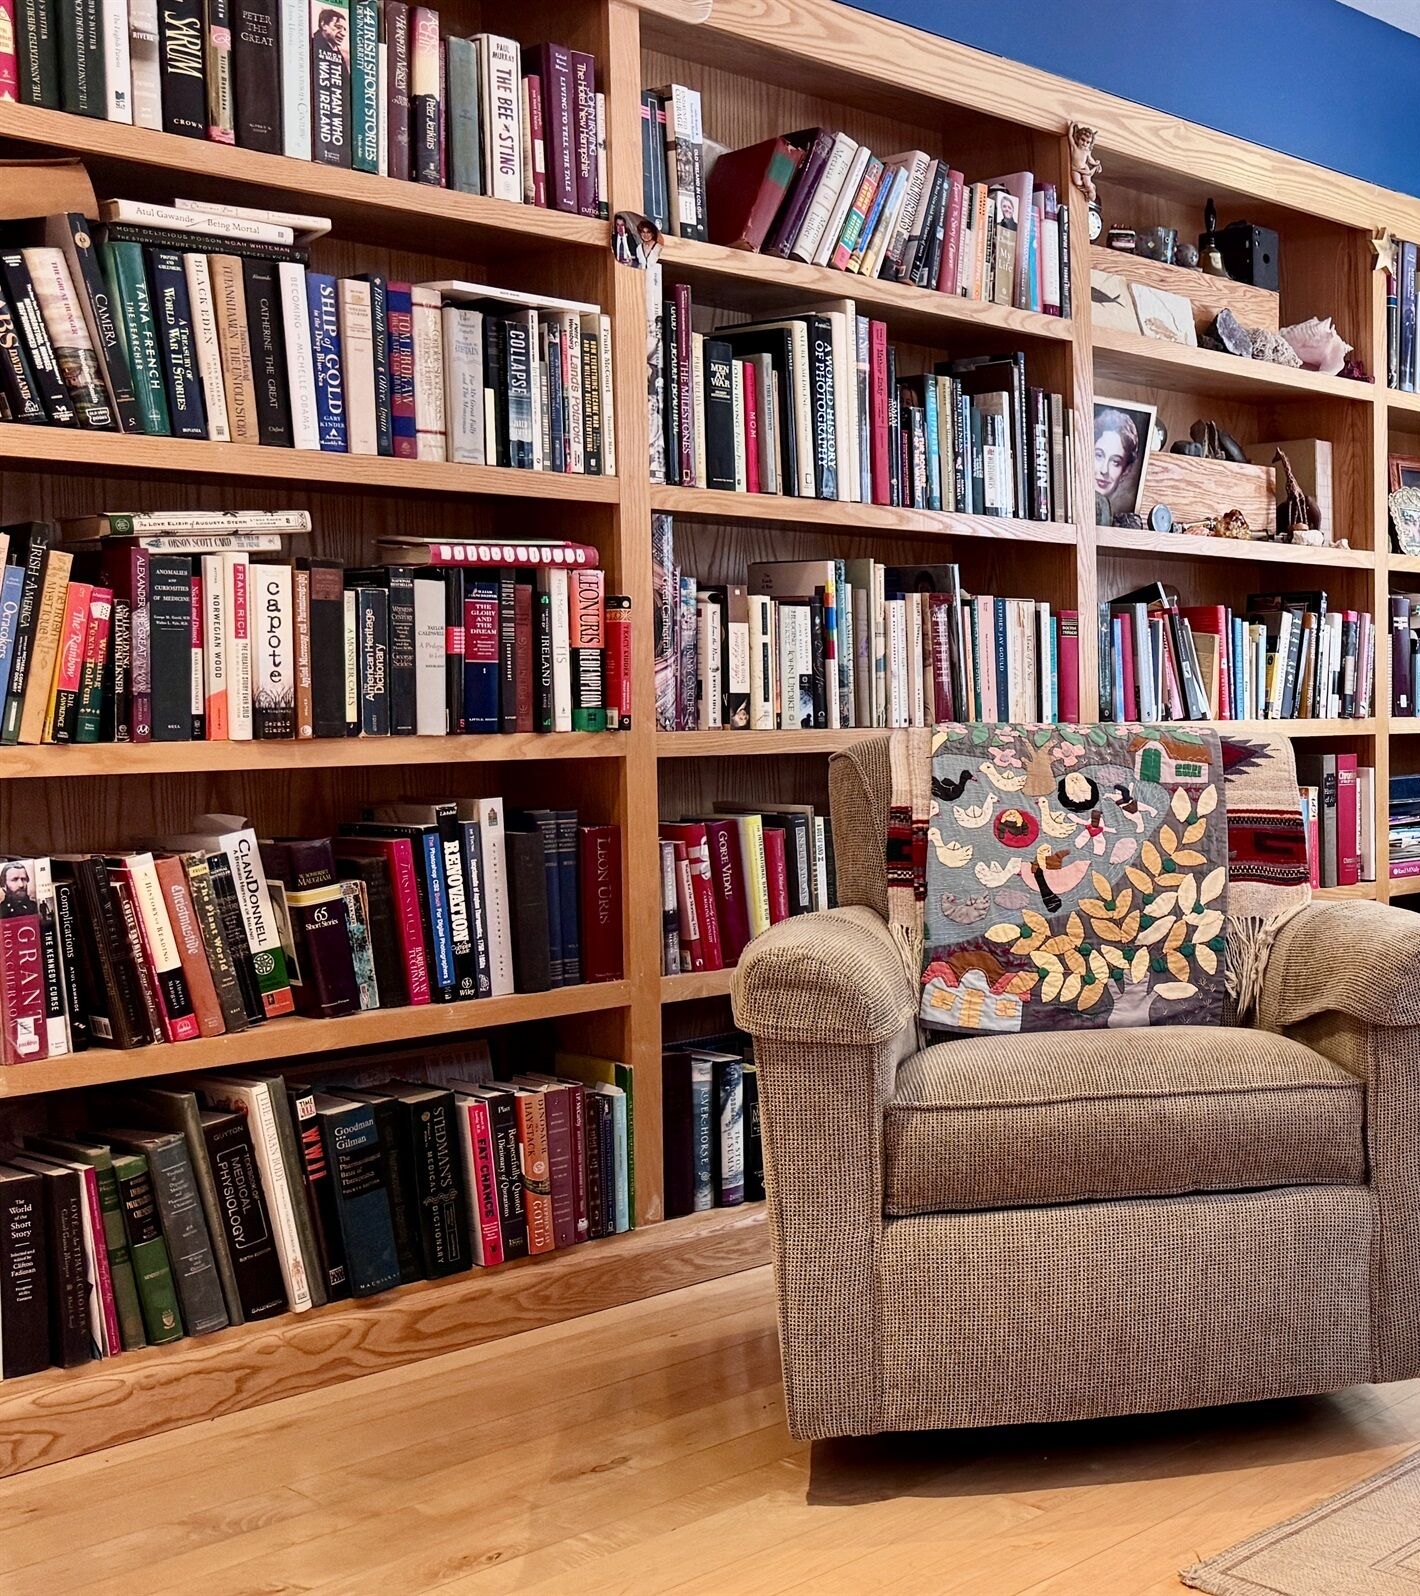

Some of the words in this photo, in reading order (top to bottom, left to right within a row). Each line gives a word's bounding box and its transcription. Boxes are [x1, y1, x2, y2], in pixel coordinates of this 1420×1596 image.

[242, 10, 272, 25] PETER
[246, 22, 268, 34] THE
[363, 7, 375, 24] 44
[164, 10, 203, 80] SARUM
[240, 32, 274, 47] GREAT
[364, 26, 375, 61] IRISH
[319, 61, 330, 87] WAS
[331, 60, 342, 88] THE
[364, 61, 376, 108] SHORT
[496, 69, 512, 93] THE
[319, 89, 330, 143] IRELAND
[332, 87, 343, 117] MAN
[426, 98, 436, 118] Peter
[498, 97, 514, 121] BEE
[586, 89, 597, 118] JOHN
[674, 88, 683, 129] COURAGE
[173, 118, 203, 129] CROWN
[332, 117, 343, 146] WHO
[365, 109, 376, 161] STORIES
[426, 118, 436, 150] Jenkins
[588, 118, 597, 156] IRVING
[499, 134, 515, 176] STING
[916, 156, 930, 174] THE
[136, 207, 156, 219] Atul
[158, 209, 195, 224] Gawande
[898, 172, 927, 235] CONQUERORS
[117, 226, 140, 235] MOST
[143, 229, 188, 241] DELICIOUS
[190, 235, 223, 244] POISON
[225, 239, 248, 248] NOAH
[250, 242, 290, 253] WHITEMAN
[207, 218, 231, 231] Being
[232, 223, 260, 235] Mortal
[999, 259, 1014, 273] Life
[1001, 247, 1011, 259] My
[126, 301, 135, 318] THE
[163, 287, 176, 325] WORLD
[194, 259, 208, 306] BLACK
[201, 310, 213, 346] EDEN
[291, 276, 302, 329] BECOMING
[319, 284, 337, 337] SHIP
[95, 293, 116, 348] CAMERA
[135, 283, 149, 324] TANA
[142, 330, 160, 390] FRENCH
[260, 297, 273, 352] CATHERINE
[399, 314, 411, 342] TOM
[130, 321, 143, 371] SEARCHER
[168, 328, 180, 350] WAR
[321, 337, 334, 350] of
[815, 341, 825, 356] OF
[824, 342, 832, 353] A
[9, 349, 24, 374] DAVID
[171, 352, 183, 365] II
[265, 355, 275, 375] THE
[297, 343, 307, 391] MICHELLE
[510, 330, 526, 396] COLLAPSE
[680, 359, 689, 383] THE
[16, 374, 31, 400] LAMB
[173, 366, 186, 411] STORIES
[267, 378, 278, 409] GREAT
[326, 353, 343, 415] GOLD
[400, 347, 413, 406] BROKAW
[825, 355, 834, 406] WORLD
[301, 394, 310, 431] OBAMA
[681, 385, 691, 455] MILESTONES
[749, 411, 757, 439] MOM
[816, 359, 827, 469] PHOTOGRAPHY
[827, 410, 836, 469] HISTORY
[1036, 424, 1048, 488] LENIN
[168, 537, 191, 547] ORSON
[192, 536, 214, 547] SCOTT
[214, 536, 232, 547] CARD
[154, 584, 189, 592] CURIOSITIES
[235, 565, 245, 608] FRANK
[578, 572, 600, 611] LEON
[661, 577, 670, 604] Great
[115, 604, 123, 644] WILLIAM
[212, 594, 222, 650] NORWEGIAN
[236, 609, 246, 639] RICH
[266, 581, 282, 684] capote
[365, 608, 376, 652] Heritage
[579, 613, 601, 645] URIS
[94, 637, 107, 690] Winning
[115, 644, 123, 694] FAULKNER
[213, 653, 222, 680] WOOD
[374, 643, 386, 694] Dictionary
[541, 635, 551, 687] IRELAND
[686, 642, 694, 673] JIMMY
[786, 650, 796, 674] JOHN
[365, 652, 376, 702] American
[579, 649, 602, 709] REDEMPTION
[687, 675, 695, 713] CARTER
[57, 693, 68, 728] LAWRENCE
[786, 677, 796, 713] UPDIKE
[718, 831, 732, 864] GORE
[443, 840, 470, 942] RENOVATION
[721, 864, 733, 899] VIDAL
[171, 884, 198, 955] Christmastide
[313, 905, 328, 922] 65
[703, 891, 711, 918] CAROLINE
[45, 931, 53, 947] THE
[60, 887, 75, 958] Complications
[705, 918, 713, 943] KENNEDY
[17, 926, 43, 1025] GRANT
[47, 948, 57, 983] KENNEDY
[50, 986, 60, 1011] CURSE
[261, 1096, 274, 1117] THE
[265, 1118, 282, 1155] HUMAN
[334, 1118, 375, 1137] Goodman
[336, 1135, 367, 1150] Gilman
[524, 1102, 536, 1157] HAYSTACK
[699, 1086, 711, 1165] RIVER-HORSE
[433, 1107, 452, 1188] STEDMAN'S
[507, 1128, 521, 1181] Respectfully
[230, 1156, 252, 1215] MEDICAL
[273, 1156, 285, 1182] BODY
[427, 1151, 437, 1193] MEDICAL
[9, 1204, 33, 1216] World
[217, 1162, 246, 1243] PHYSIOLOGY
[512, 1182, 524, 1215] Quoted
[10, 1221, 32, 1231] Short
[11, 1229, 33, 1240] Story
[431, 1205, 445, 1263] DICTIONARY
[532, 1200, 545, 1247] GOULD
[11, 1268, 37, 1279] Fadiman
[12, 1261, 35, 1270] Clifton
